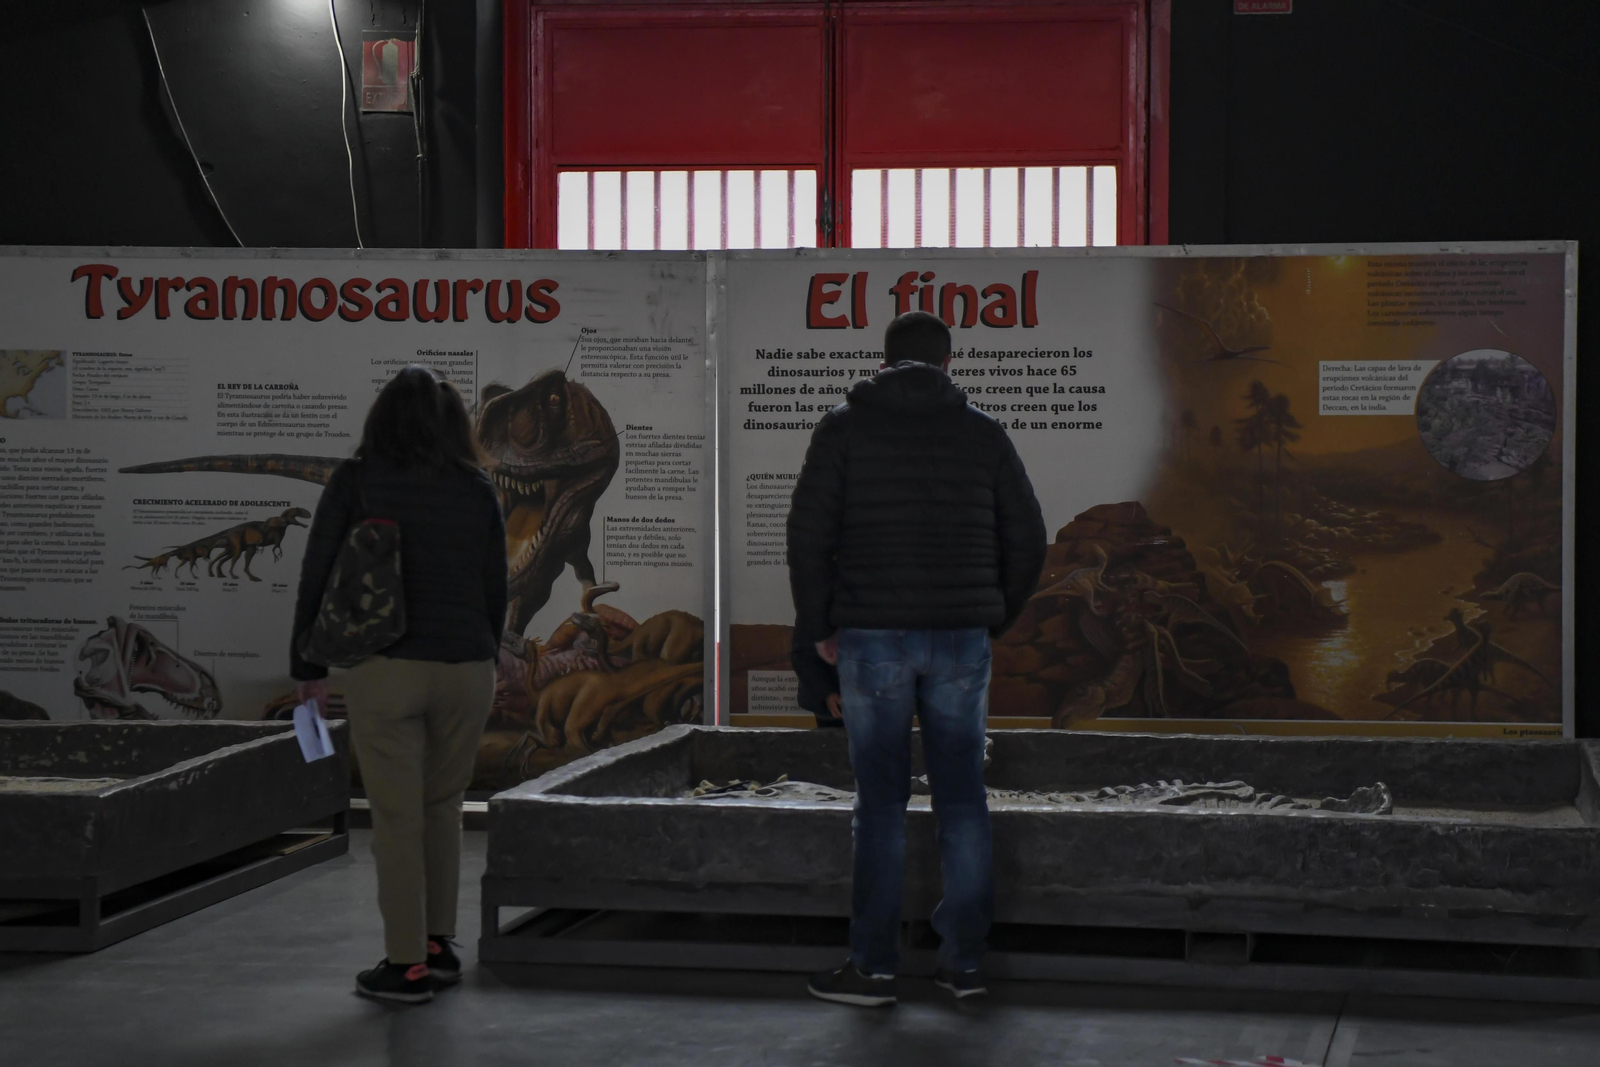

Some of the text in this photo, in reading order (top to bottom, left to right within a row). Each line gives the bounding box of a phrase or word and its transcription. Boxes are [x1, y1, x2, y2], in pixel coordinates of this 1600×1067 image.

[71, 264, 560, 323] Tyrannosaurus
[806, 270, 1039, 329] El final
[756, 346, 1093, 361] Nadie sabe exactam desaparecieron los
[448, 359, 473, 367] grandes
[768, 366, 844, 377] dinosaurios
[848, 369, 855, 380] y
[989, 365, 1023, 376] vivos
[1026, 365, 1056, 376] hace
[1060, 365, 1077, 376] 65
[1322, 375, 1359, 383] erupciones
[740, 384, 796, 394] millones
[799, 384, 814, 394] de
[818, 384, 849, 394] años
[1025, 386, 1049, 396] que
[1052, 382, 1064, 394] la
[1322, 384, 1348, 393] período
[1378, 394, 1400, 402] región
[748, 401, 791, 412] fueron
[795, 401, 813, 412] las
[1050, 404, 1074, 414] que
[1078, 400, 1097, 411] los
[1012, 418, 1026, 429] de
[626, 459, 655, 467] pequeñas
[625, 476, 653, 484] potentes
[746, 472, 774, 481] ¿QUIÉN
[606, 560, 642, 568] cumplieran
[643, 560, 669, 568] ninguna
[746, 559, 771, 567] grandes
[751, 676, 776, 684] Aunque
